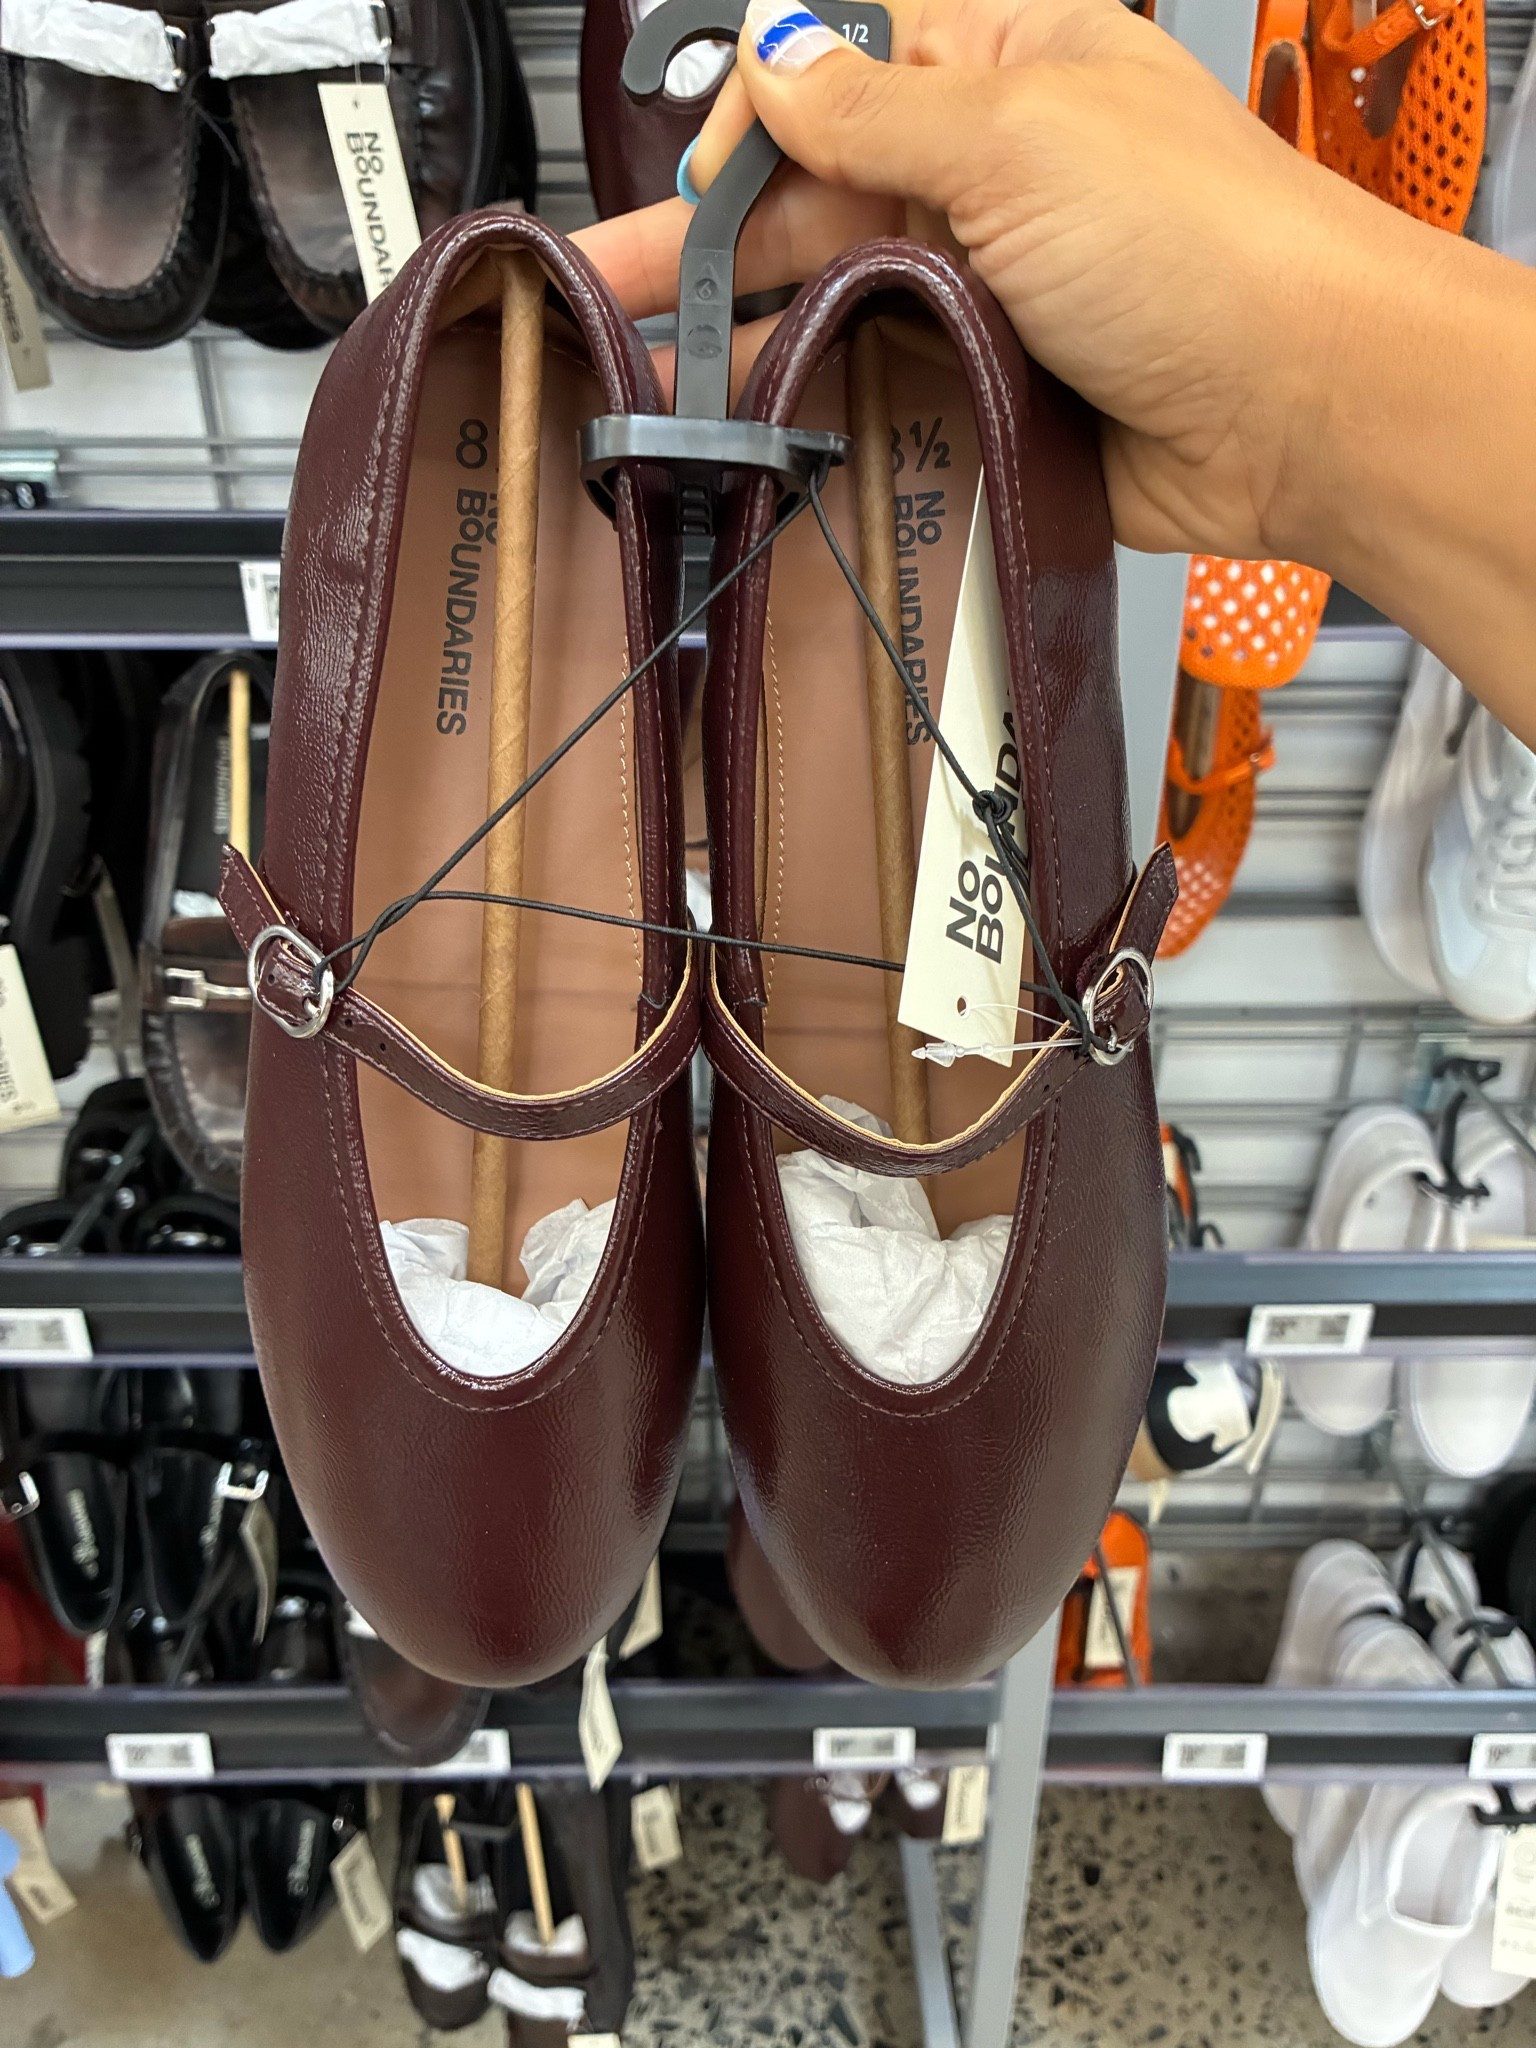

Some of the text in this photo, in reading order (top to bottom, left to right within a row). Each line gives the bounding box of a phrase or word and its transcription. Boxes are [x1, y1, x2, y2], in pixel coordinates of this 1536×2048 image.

[842, 22, 869, 44] 1/2
[455, 418, 489, 469] 8
[914, 490, 946, 545] NO
[436, 488, 487, 736] BOUNDARIES
[945, 860, 981, 950] NO
